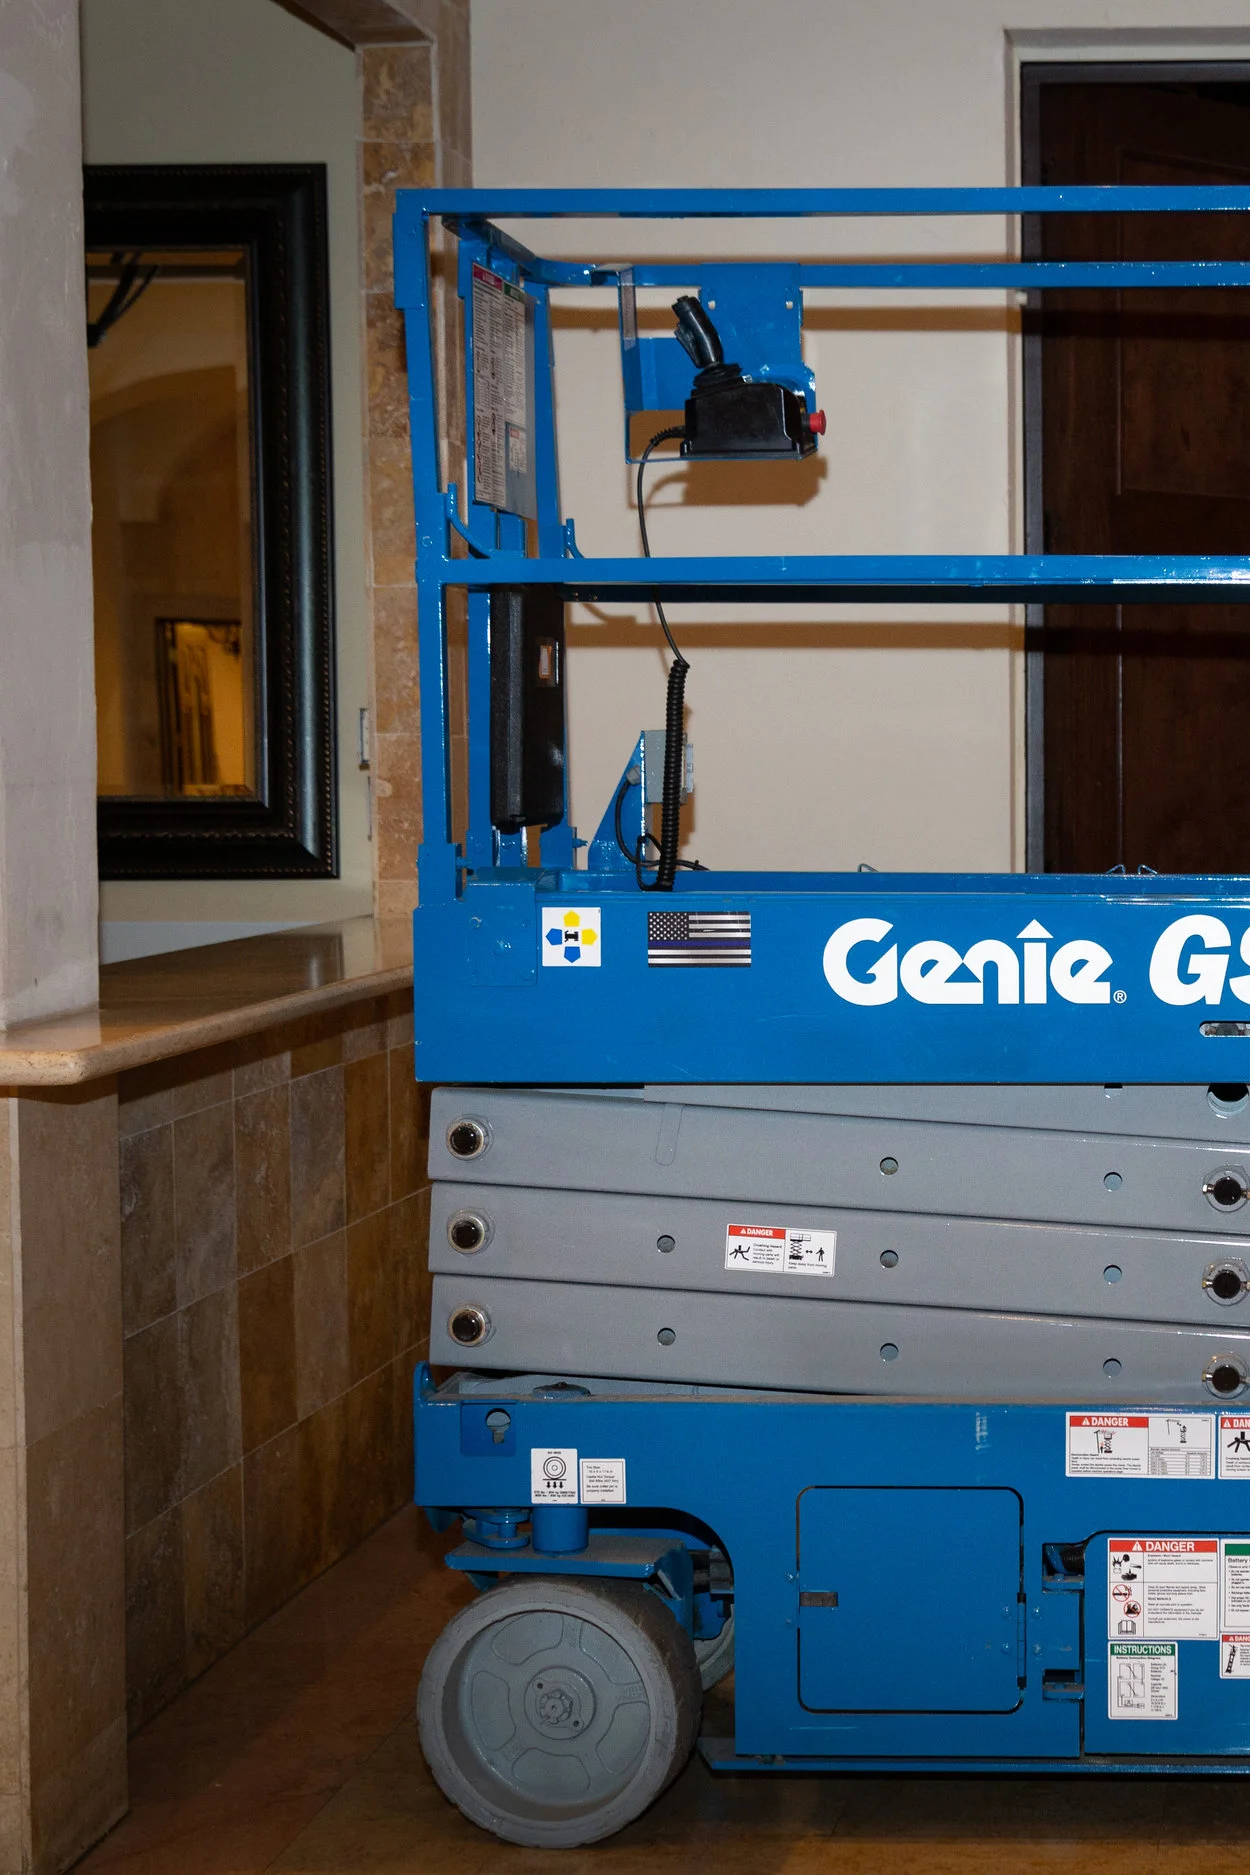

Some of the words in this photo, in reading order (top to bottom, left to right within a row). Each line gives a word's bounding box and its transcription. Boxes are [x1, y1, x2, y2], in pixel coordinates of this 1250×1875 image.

[747, 1228, 774, 1236] DANGER
[1091, 1417, 1129, 1426] DANGER
[1146, 1541, 1195, 1552] DANGER
[1114, 1645, 1172, 1654] INSTRUCTIONS
